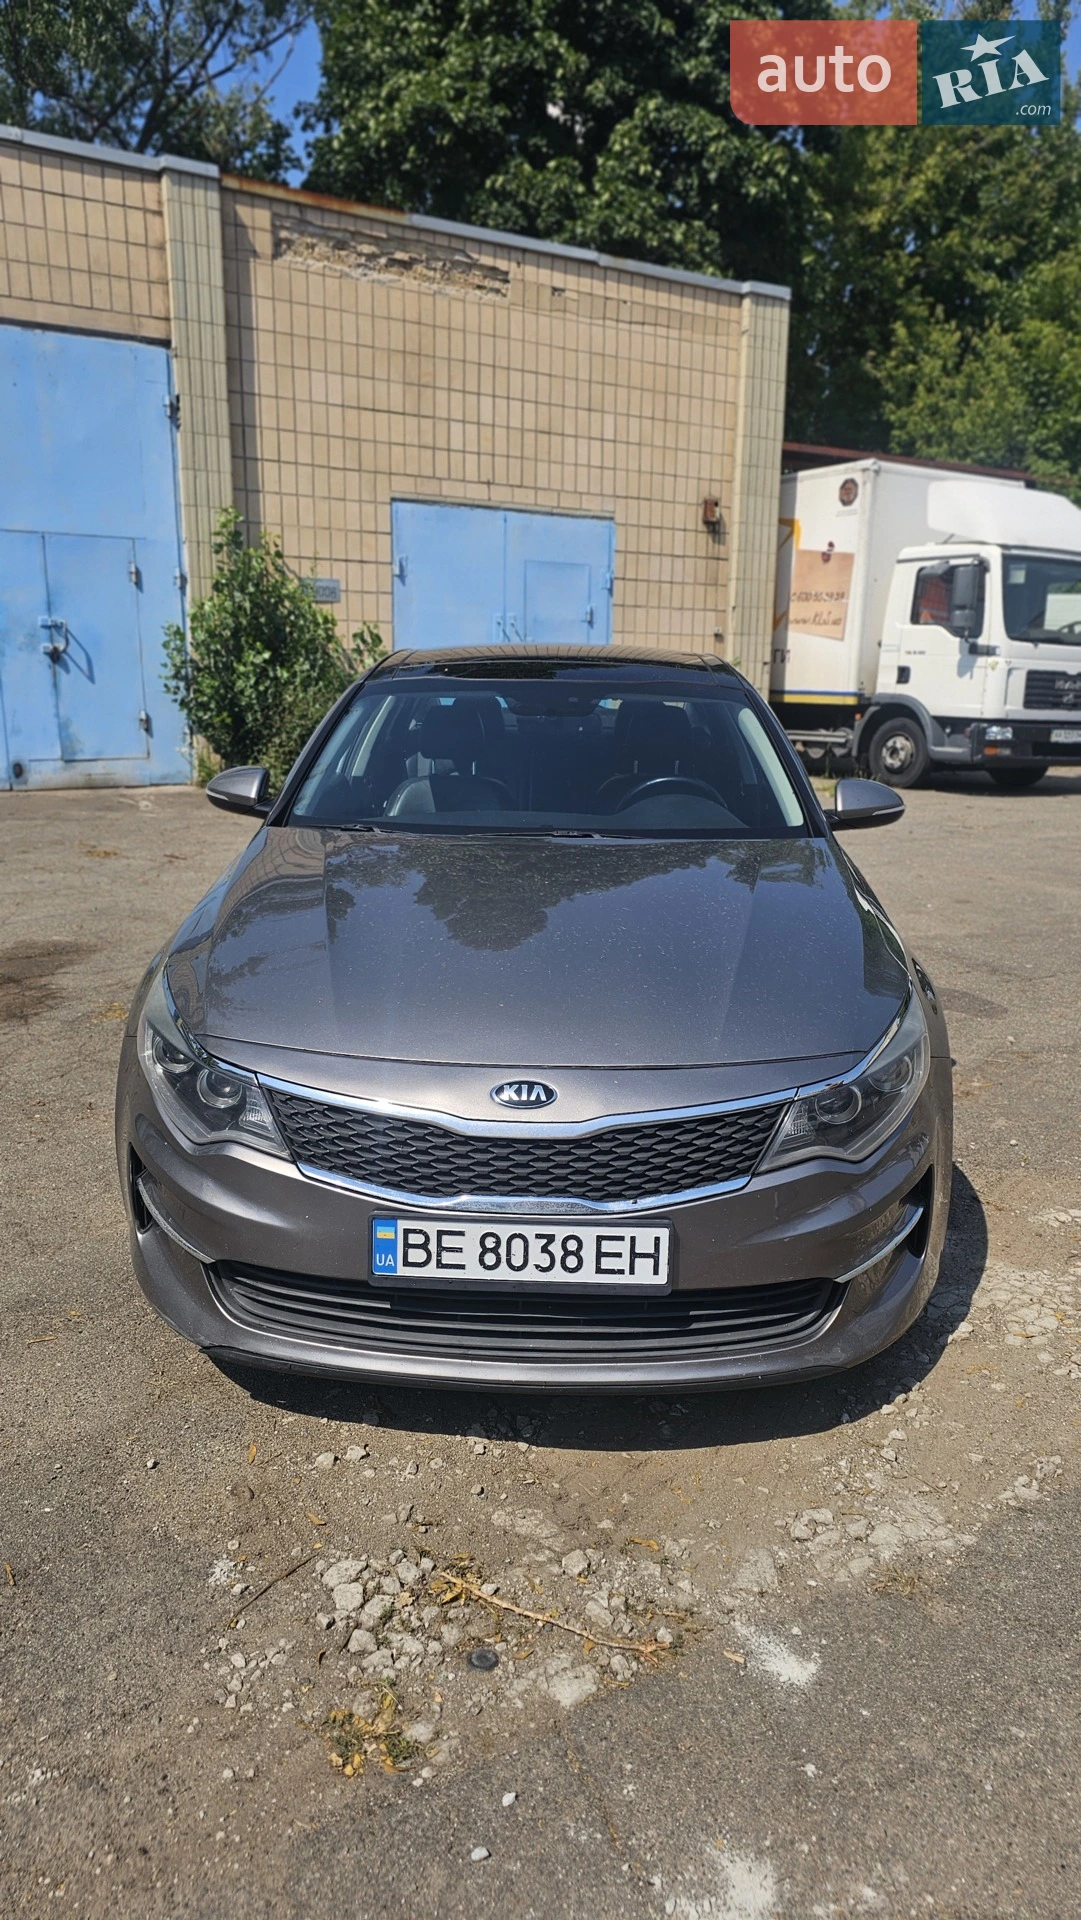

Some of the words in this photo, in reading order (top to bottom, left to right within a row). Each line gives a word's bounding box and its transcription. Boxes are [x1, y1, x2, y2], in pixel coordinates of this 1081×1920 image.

[503, 1084, 548, 1102] KIA
[376, 1254, 395, 1267] UA
[402, 1227, 467, 1271] BE
[478, 1231, 584, 1273] 8038
[595, 1234, 661, 1276] EH
